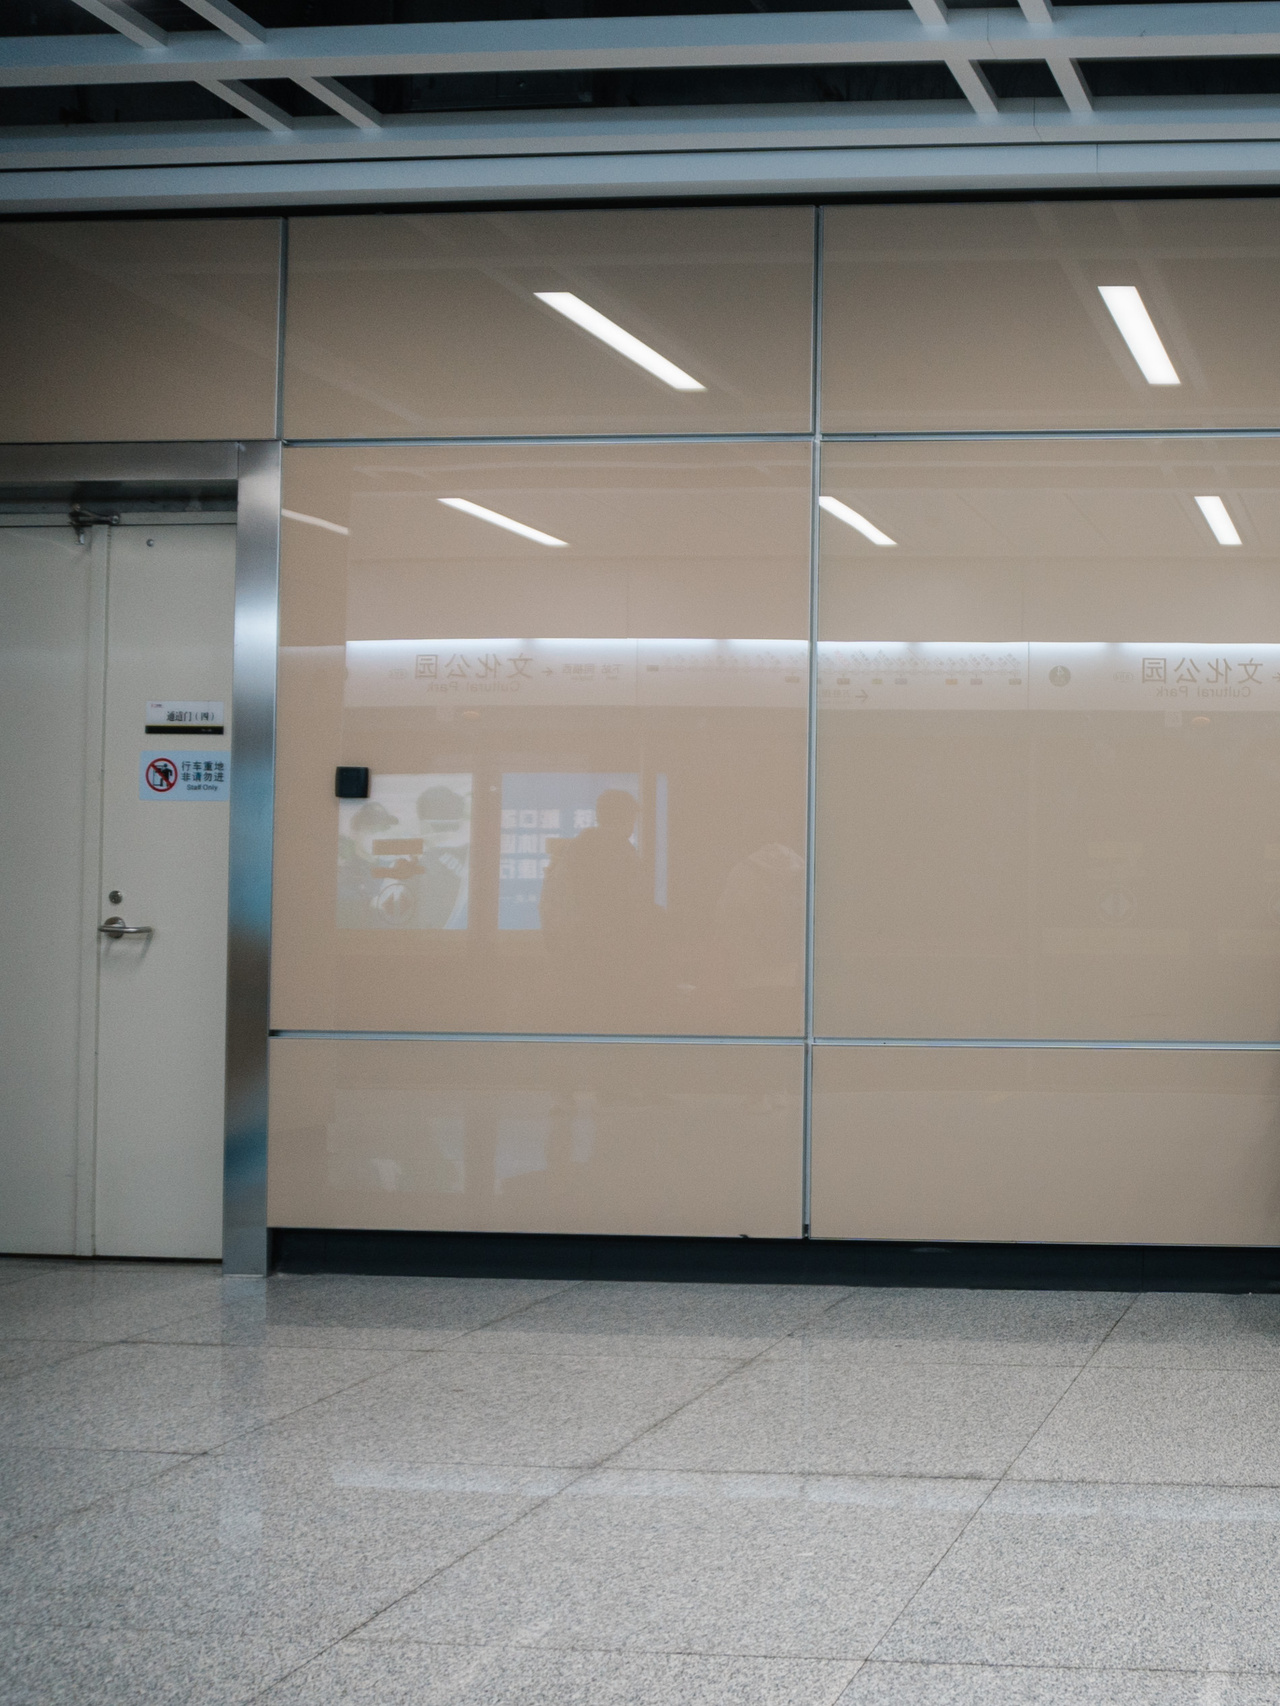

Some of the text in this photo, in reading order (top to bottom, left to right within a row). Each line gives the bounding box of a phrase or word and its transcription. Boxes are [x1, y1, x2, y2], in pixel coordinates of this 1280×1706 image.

[181, 761, 224, 772] 行车重地
[181, 771, 224, 782] 非请勿进
